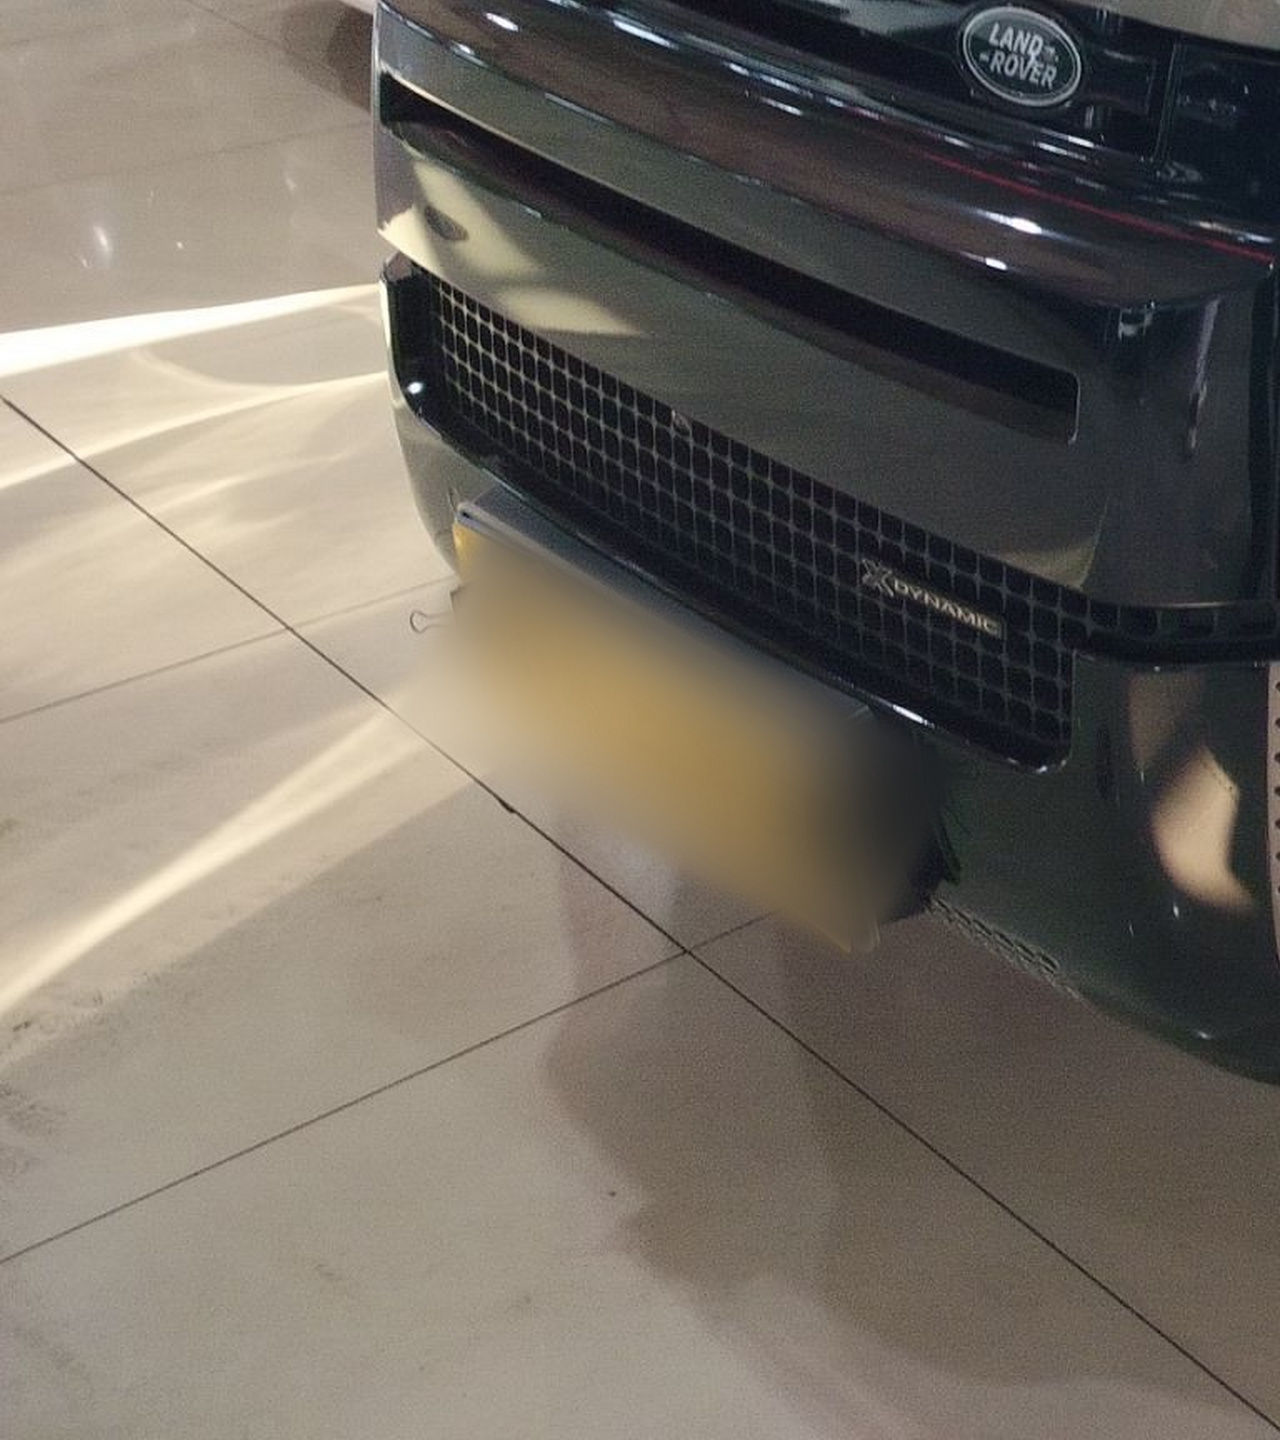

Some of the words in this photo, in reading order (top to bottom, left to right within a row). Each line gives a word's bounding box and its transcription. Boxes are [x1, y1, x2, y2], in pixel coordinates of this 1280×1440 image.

[989, 22, 1043, 57] LAND
[989, 49, 1058, 90] ROVER
[893, 575, 1003, 639] DYNAMIC
